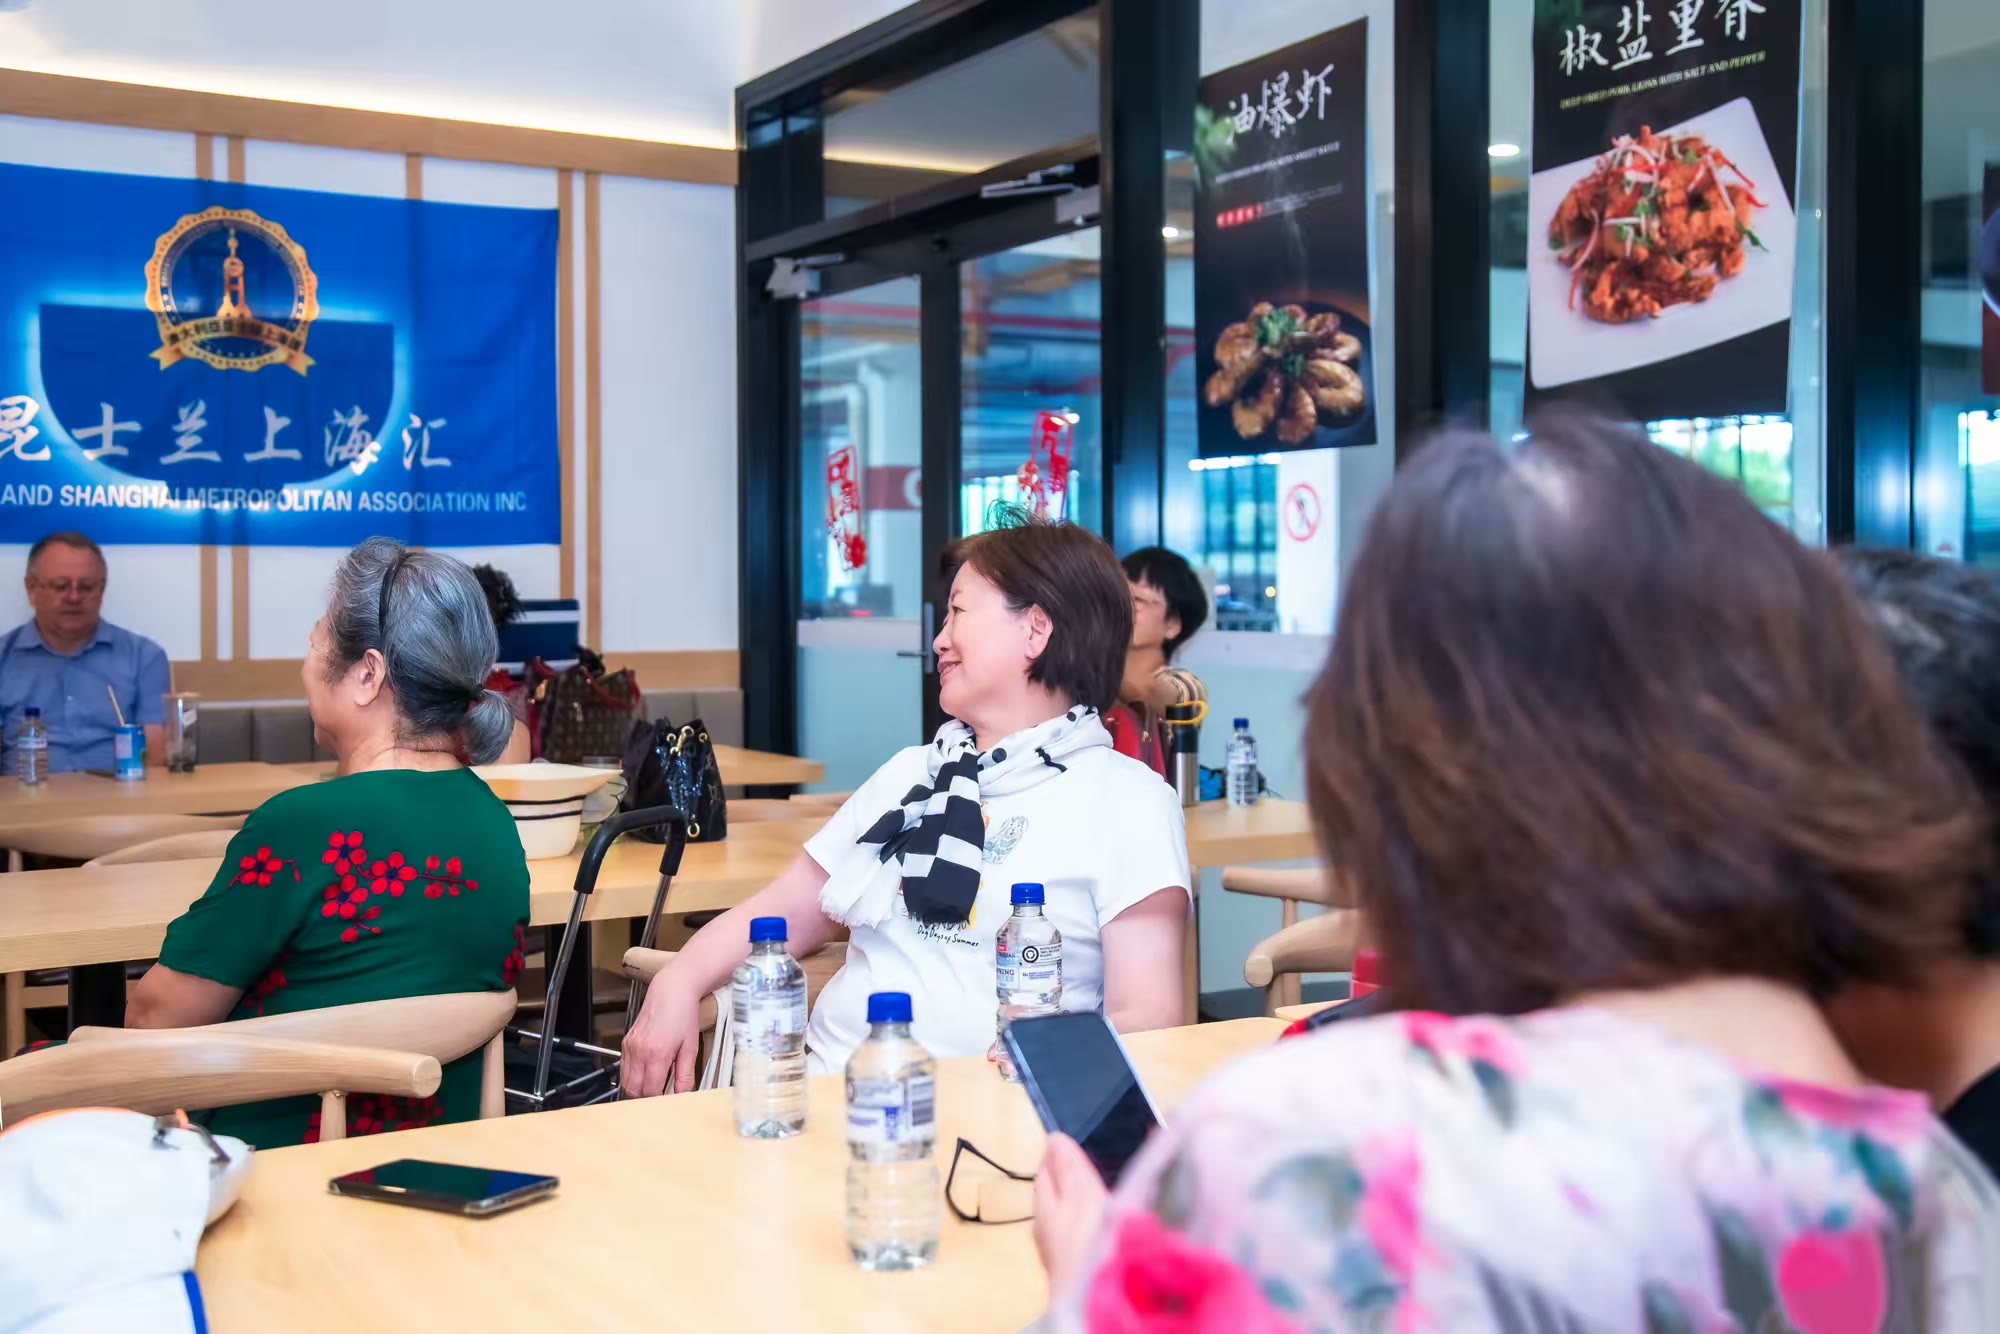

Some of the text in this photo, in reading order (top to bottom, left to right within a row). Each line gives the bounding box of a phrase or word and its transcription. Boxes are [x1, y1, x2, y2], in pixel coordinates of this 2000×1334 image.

[1226, 64, 1335, 145] 油爆虾
[2, 484, 527, 512] AND SHANGHAI METROPOLITAN ASSOCIATION INC
[917, 924, 979, 947] Dog Days of Summer
